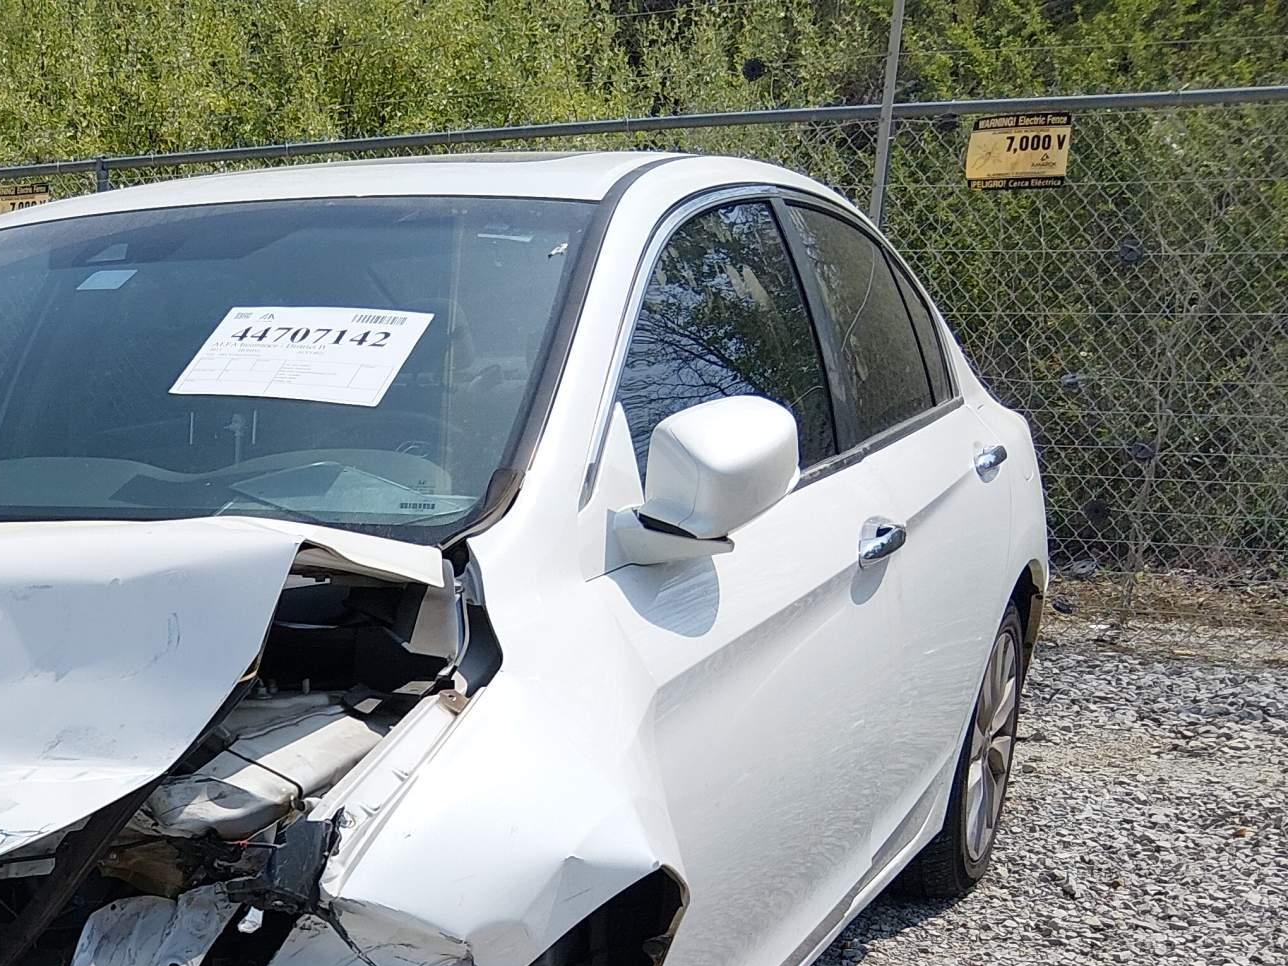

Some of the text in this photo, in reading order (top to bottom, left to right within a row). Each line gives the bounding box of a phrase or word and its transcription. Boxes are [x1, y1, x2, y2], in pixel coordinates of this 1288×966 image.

[978, 114, 1067, 129] WARNING! Electric Fence
[1006, 134, 1067, 154] 7,000 V
[1008, 179, 1030, 188] Cerca
[231, 326, 392, 347] 44707142
